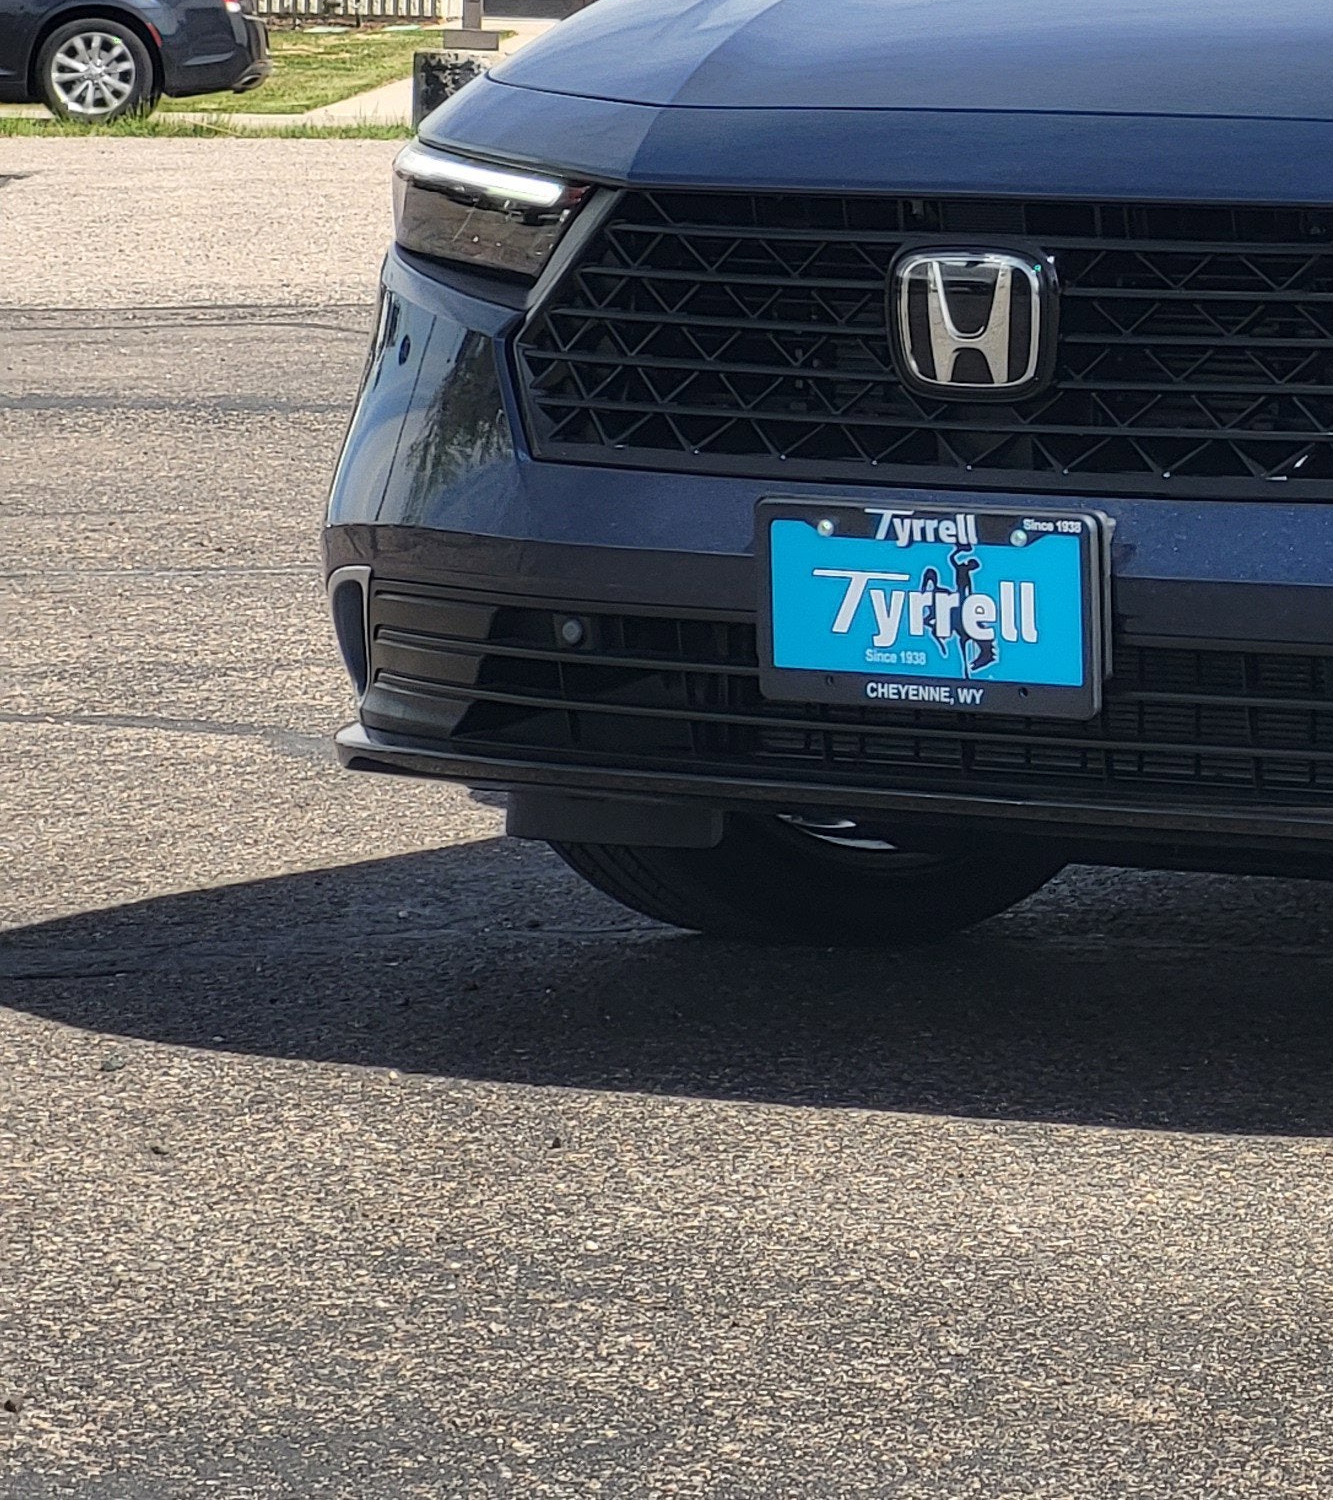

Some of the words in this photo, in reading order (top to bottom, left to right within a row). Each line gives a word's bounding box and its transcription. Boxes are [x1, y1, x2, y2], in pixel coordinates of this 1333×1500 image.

[864, 508, 978, 548] Tyrrell
[1023, 518, 1054, 532] Since
[1056, 520, 1082, 534] 1938
[812, 569, 1039, 647] Tyrrell
[865, 649, 897, 664] Since
[900, 651, 926, 666] 1938
[866, 682, 954, 706] CHEYENNE,
[957, 688, 983, 705] WY
